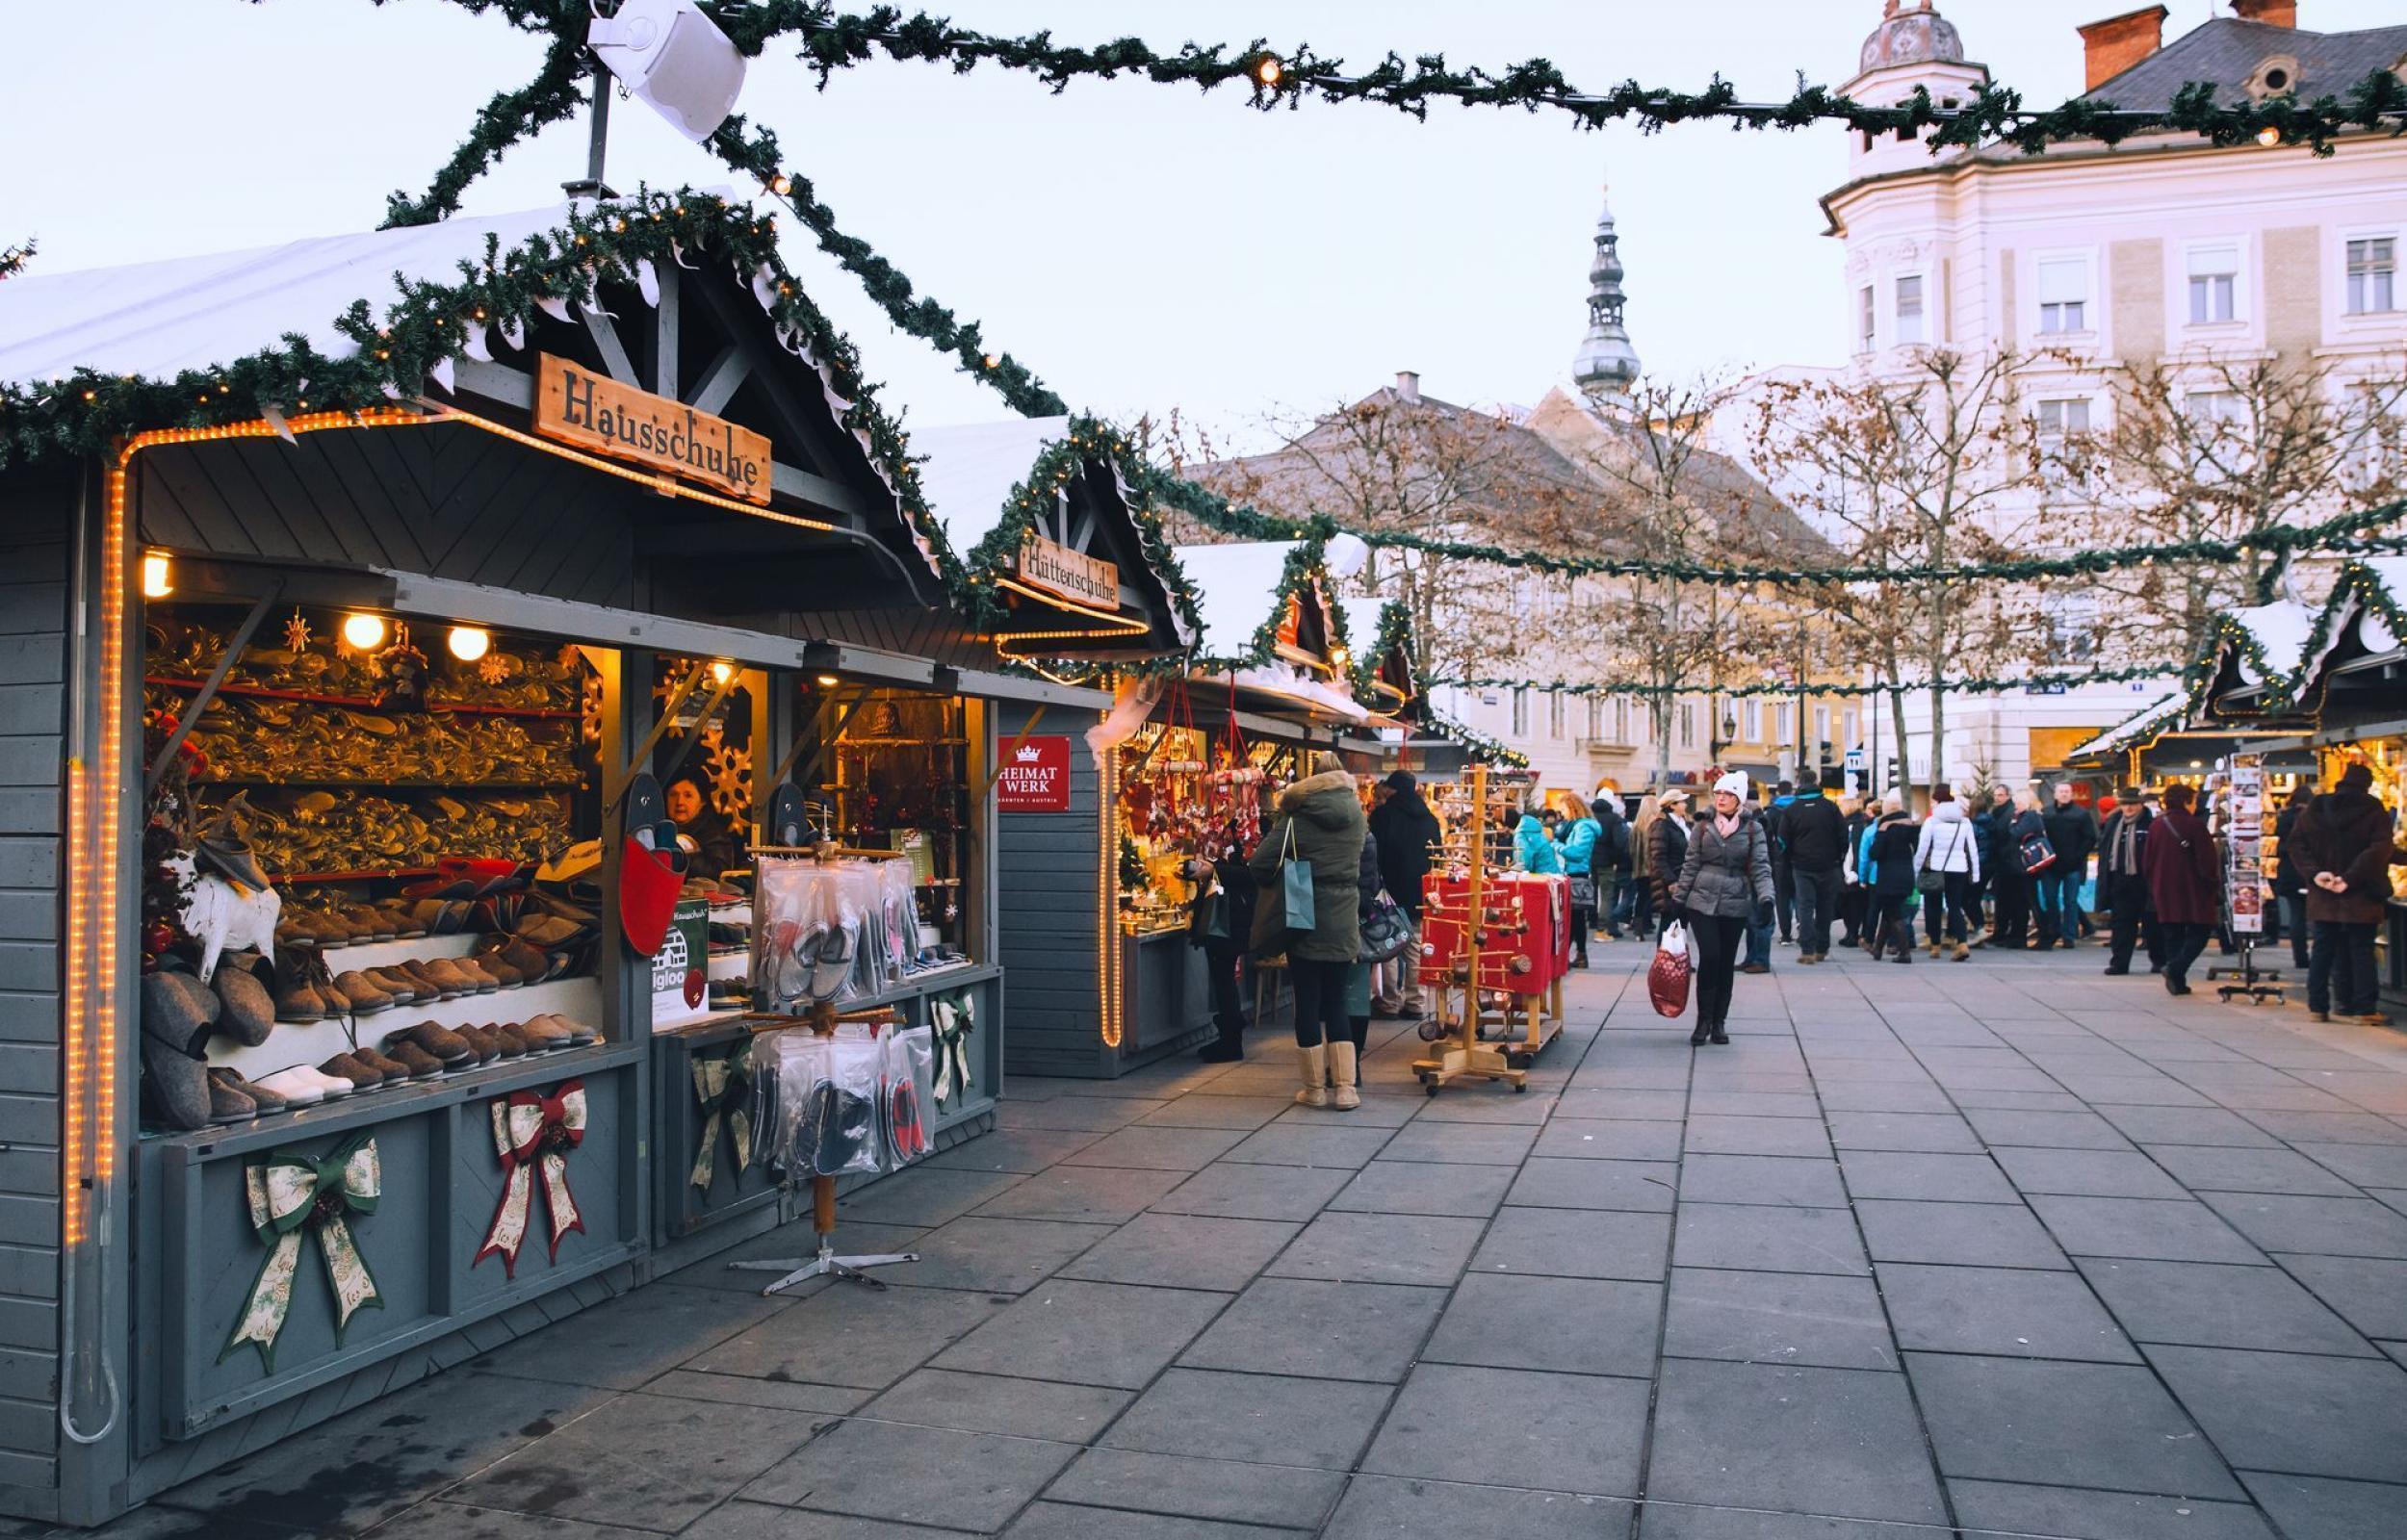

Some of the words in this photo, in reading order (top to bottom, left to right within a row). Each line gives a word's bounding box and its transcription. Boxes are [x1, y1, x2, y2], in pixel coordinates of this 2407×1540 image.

[562, 369, 759, 487] Hausschuhe
[1028, 541, 1115, 603] Hüttenschuhe
[998, 767, 1058, 780] HEIMAT
[1006, 781, 1049, 792] WERK
